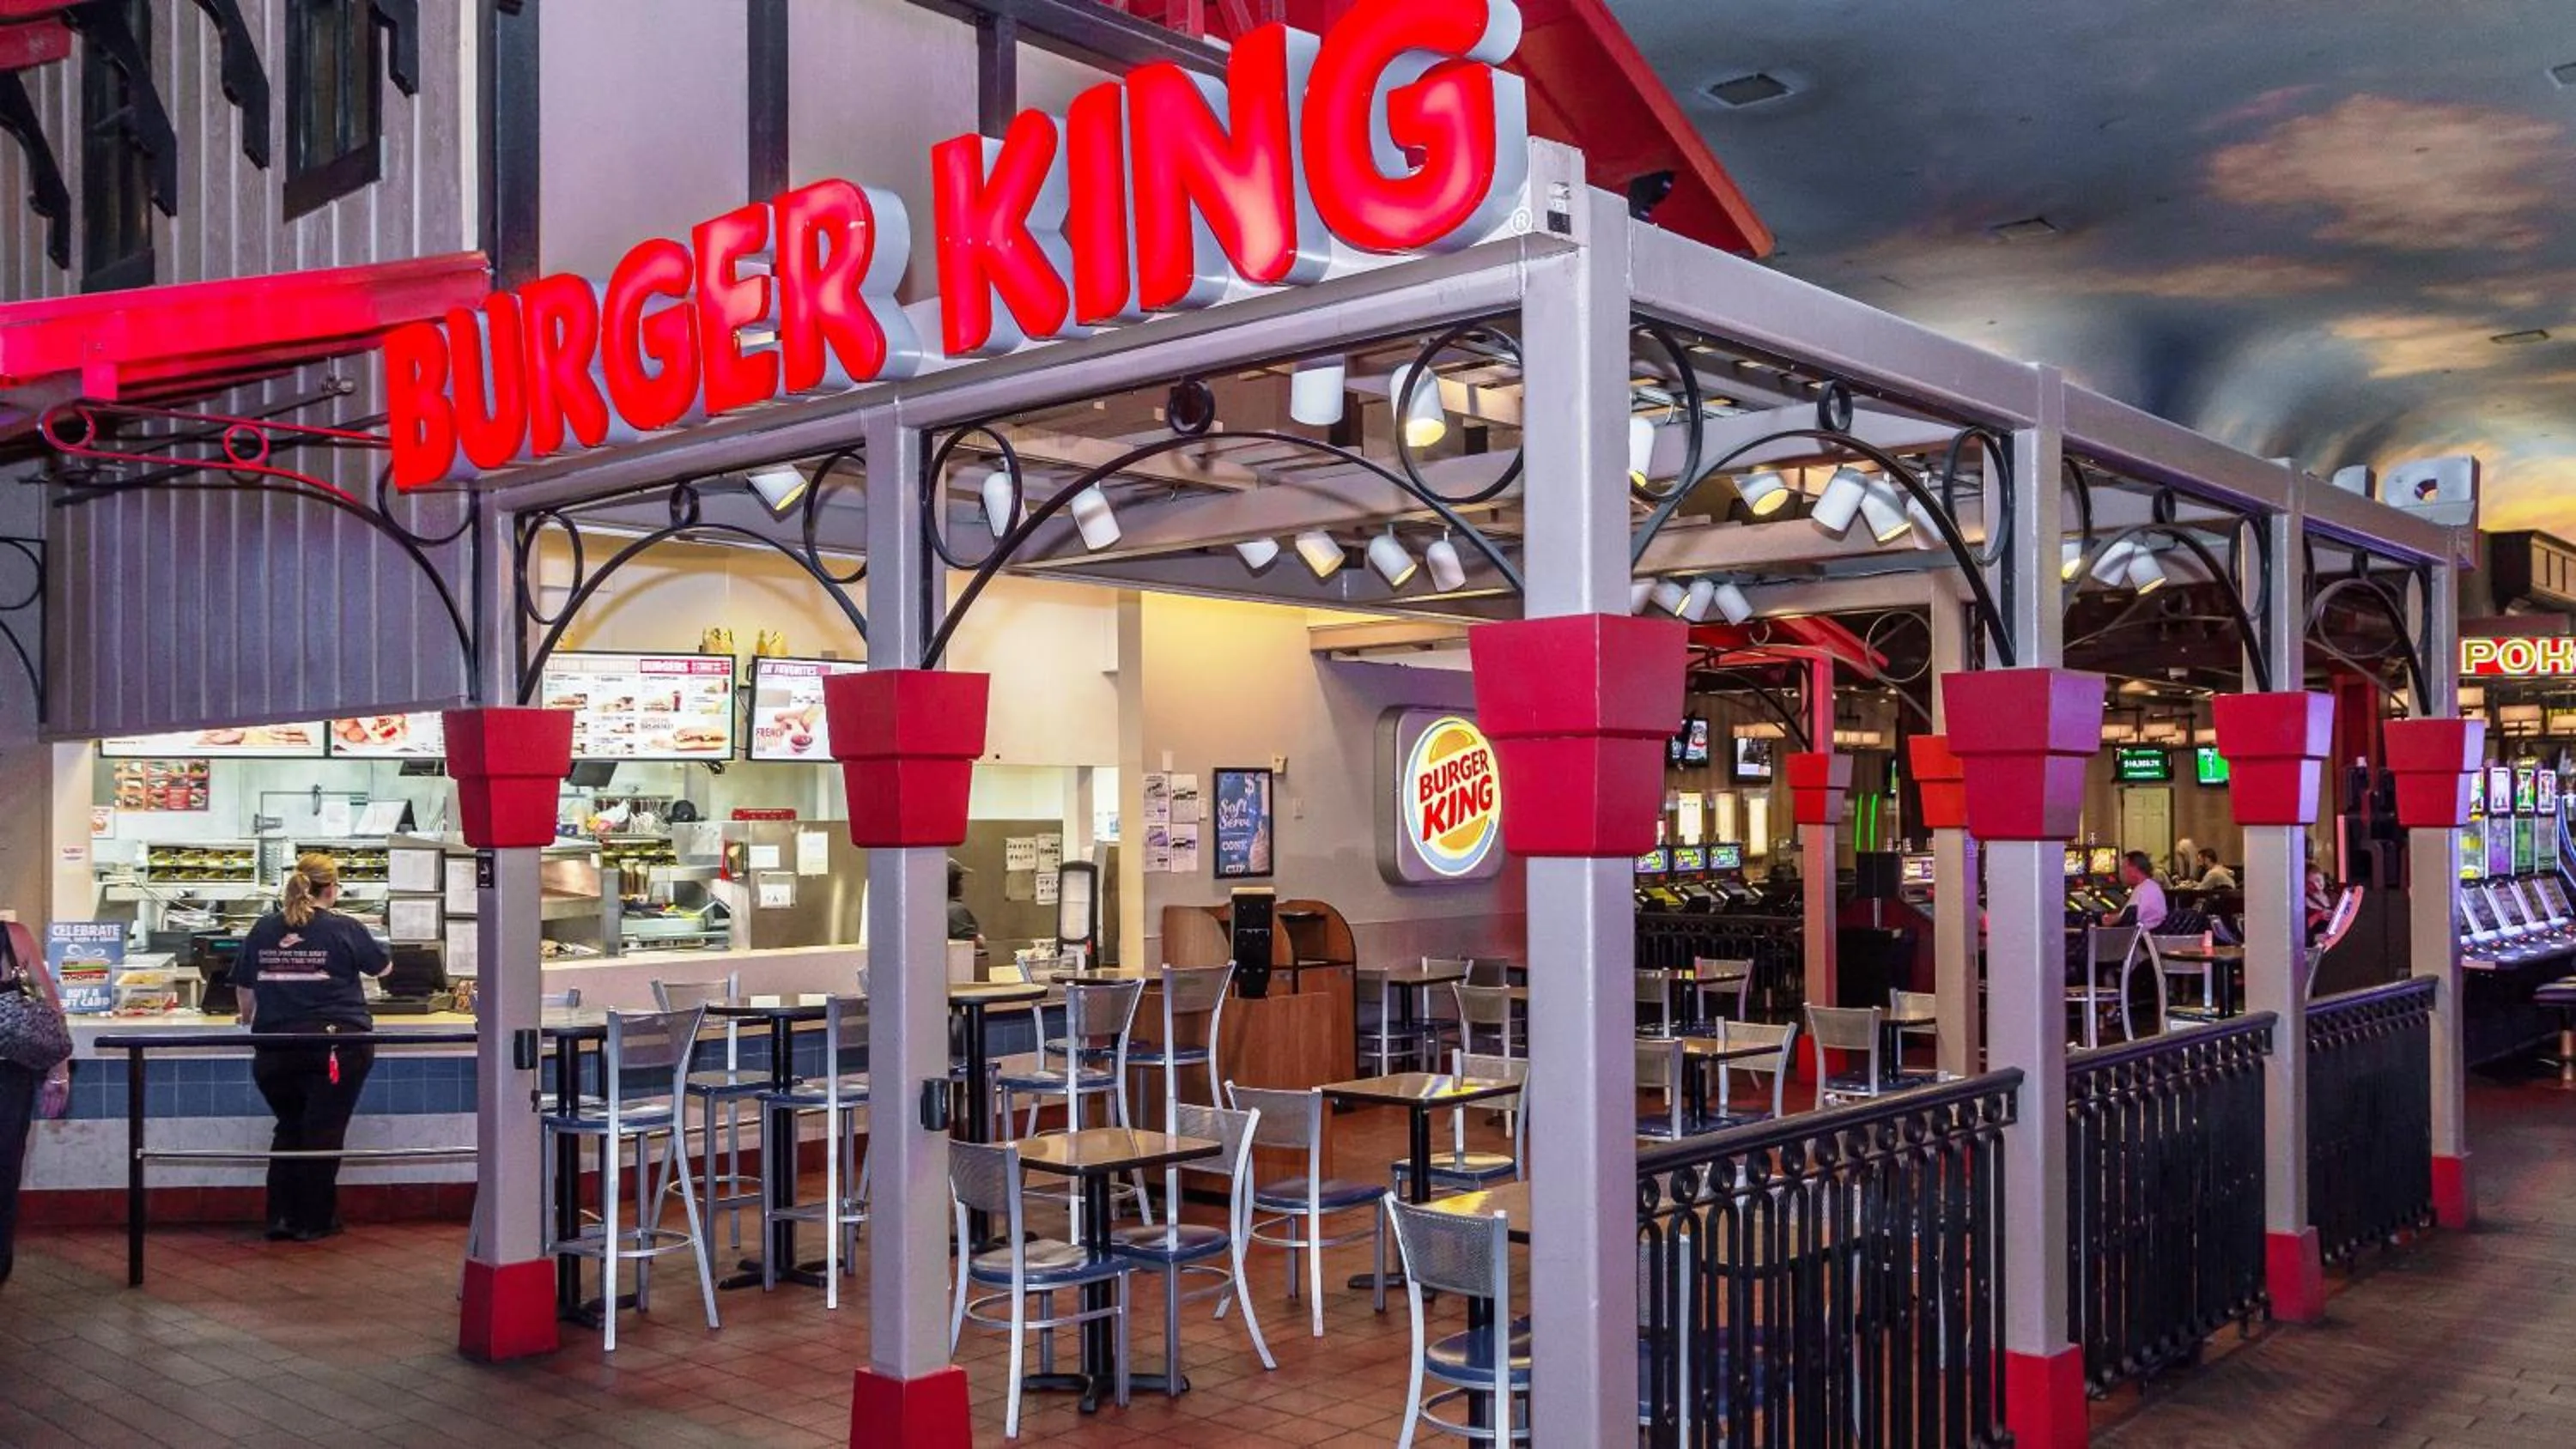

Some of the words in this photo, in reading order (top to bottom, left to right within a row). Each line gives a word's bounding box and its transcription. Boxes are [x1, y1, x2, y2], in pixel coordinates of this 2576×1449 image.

[384, 178, 888, 492] BURGER
[931, 0, 1498, 357] KING
[1419, 749, 1490, 803] BURGER
[1218, 797, 1247, 819] Soft
[1423, 774, 1492, 842] KING
[1218, 815, 1251, 830] Serve
[52, 925, 121, 937] CELEBRATE
[81, 997, 111, 1007] CARD
